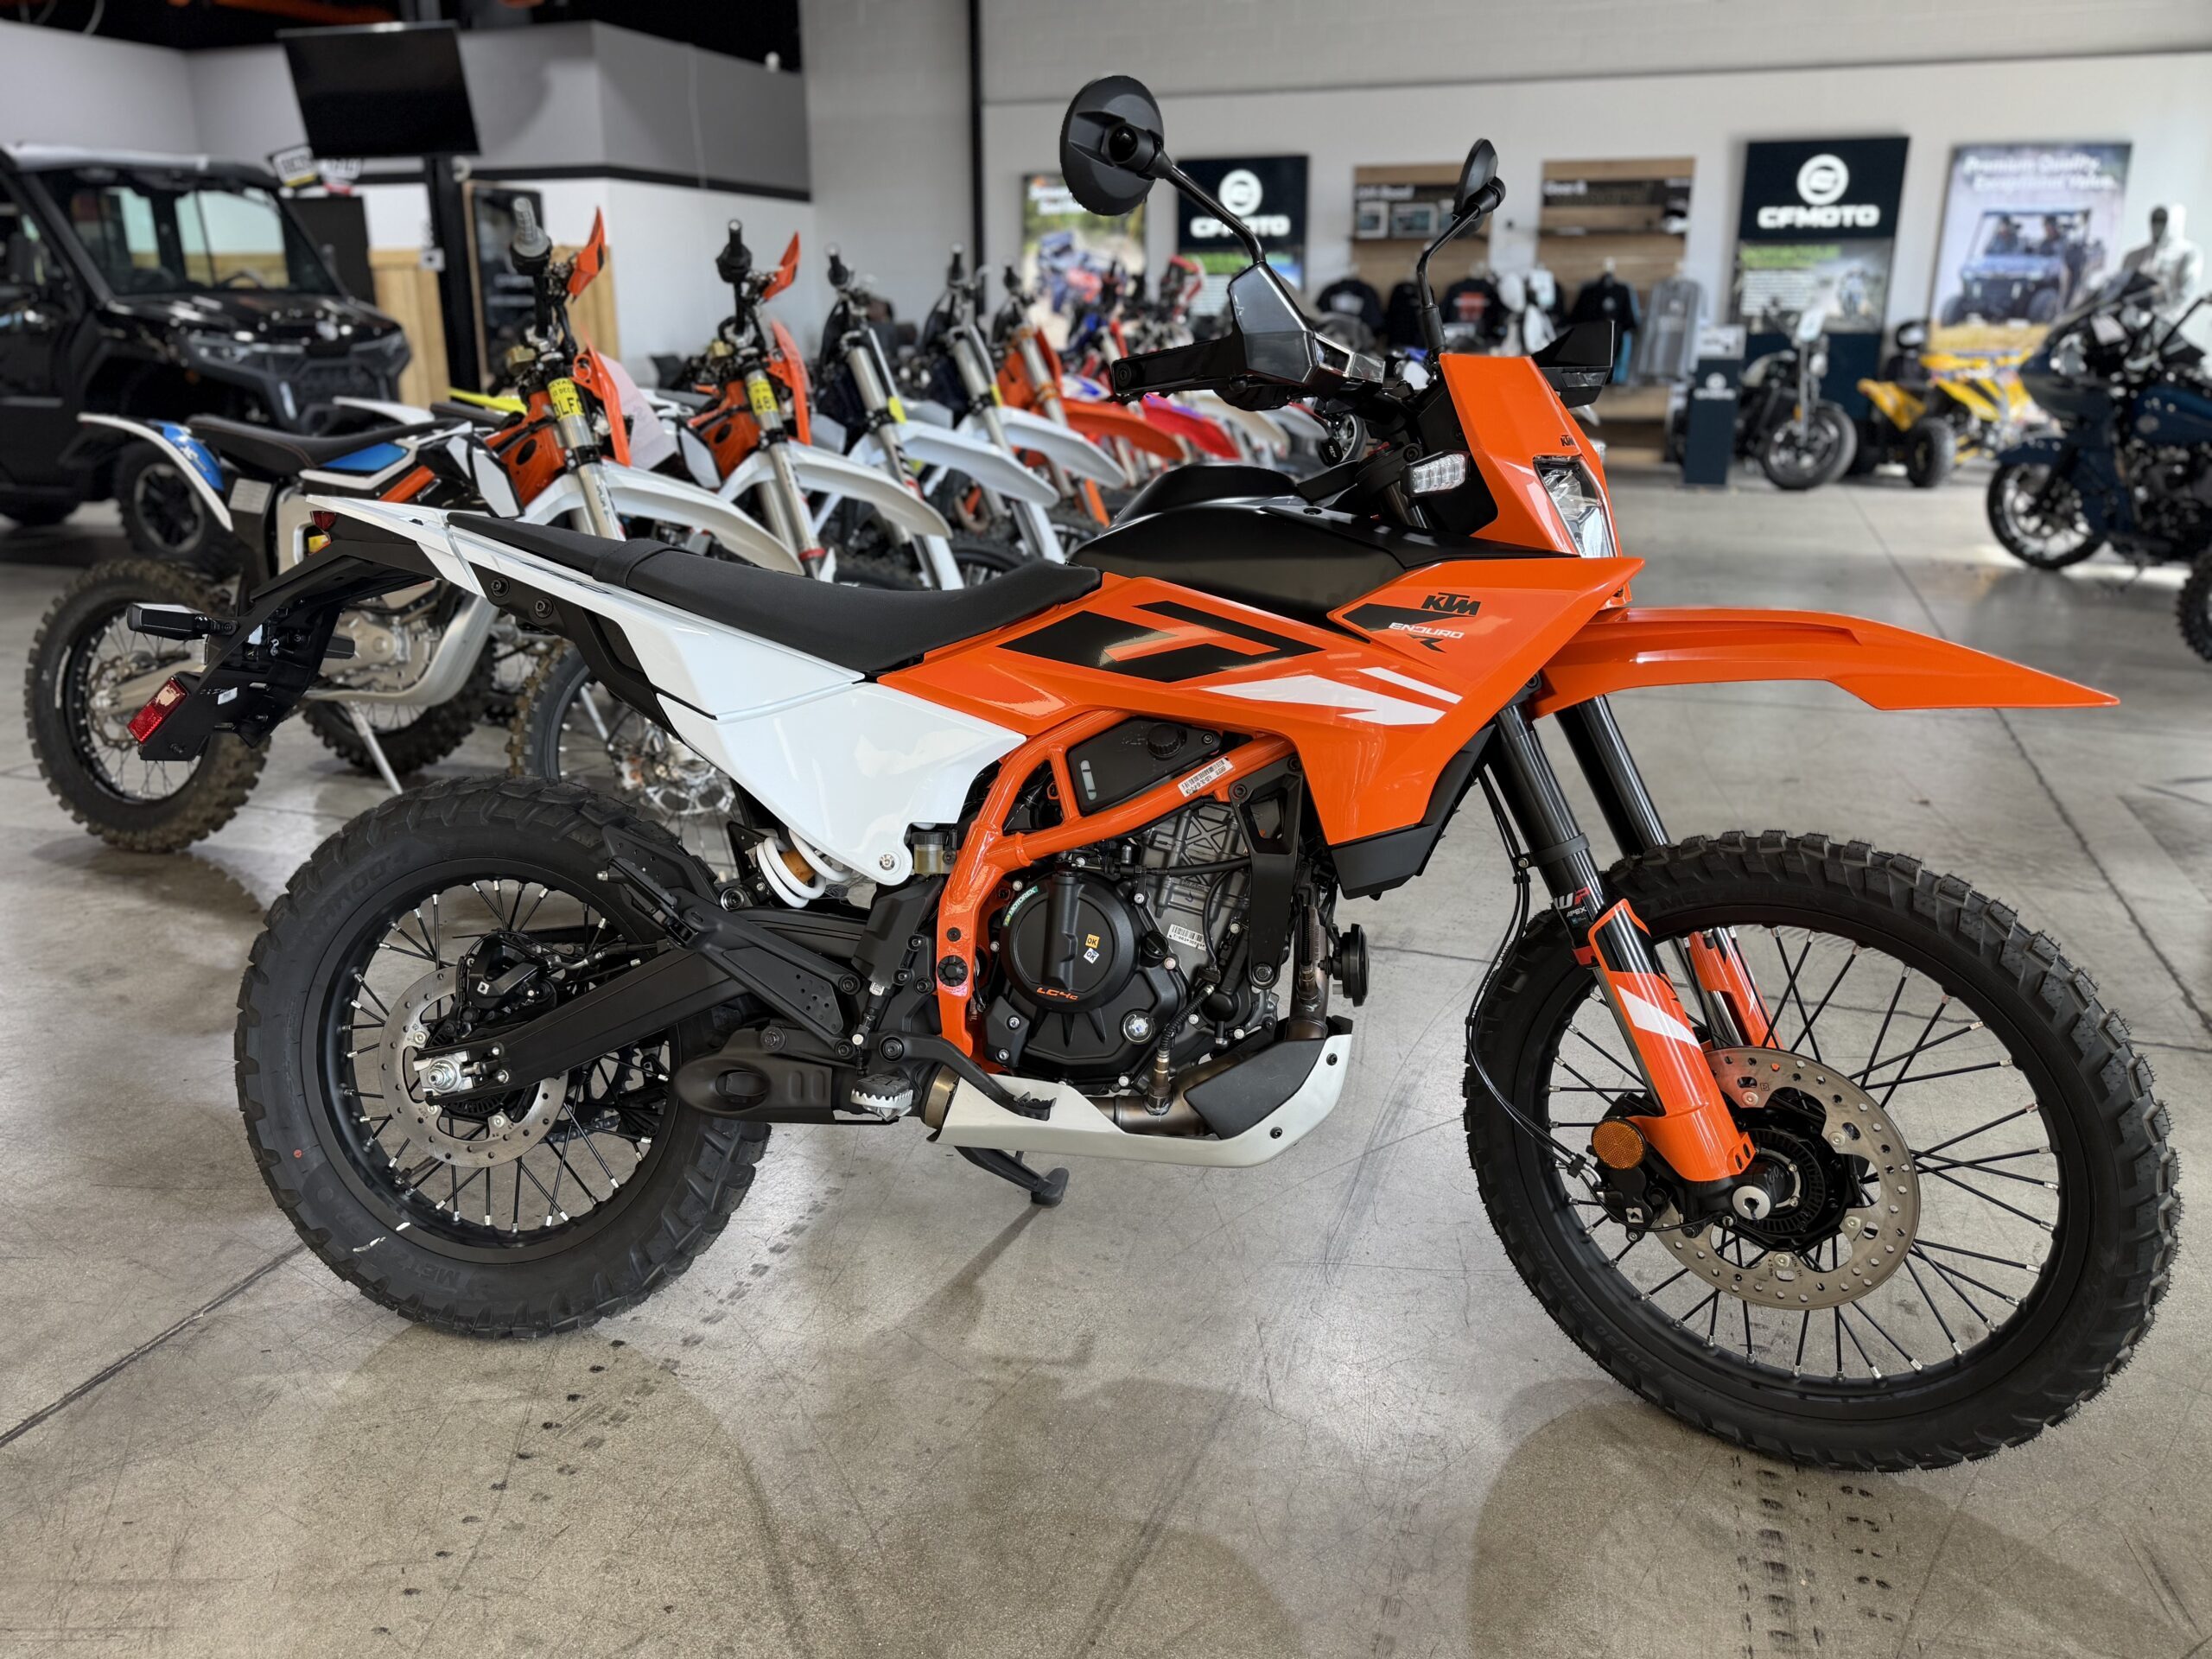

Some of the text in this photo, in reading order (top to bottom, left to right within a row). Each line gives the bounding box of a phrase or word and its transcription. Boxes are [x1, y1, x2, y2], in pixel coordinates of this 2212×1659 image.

[1189, 214, 1292, 238] CFOTO
[1758, 204, 1881, 229] CFMOTO
[1560, 435, 1576, 447] KTM
[1421, 592, 1482, 616] KTM
[1388, 622, 1465, 639] ENDURO
[1406, 633, 1447, 654] R
[1008, 886, 1036, 916] MOTOREX
[1554, 886, 1591, 910] WP
[1567, 906, 1587, 918] APEX
[1087, 938, 1097, 946] OK
[1086, 950, 1096, 961] OK
[1037, 987, 1079, 1001] LC4c
